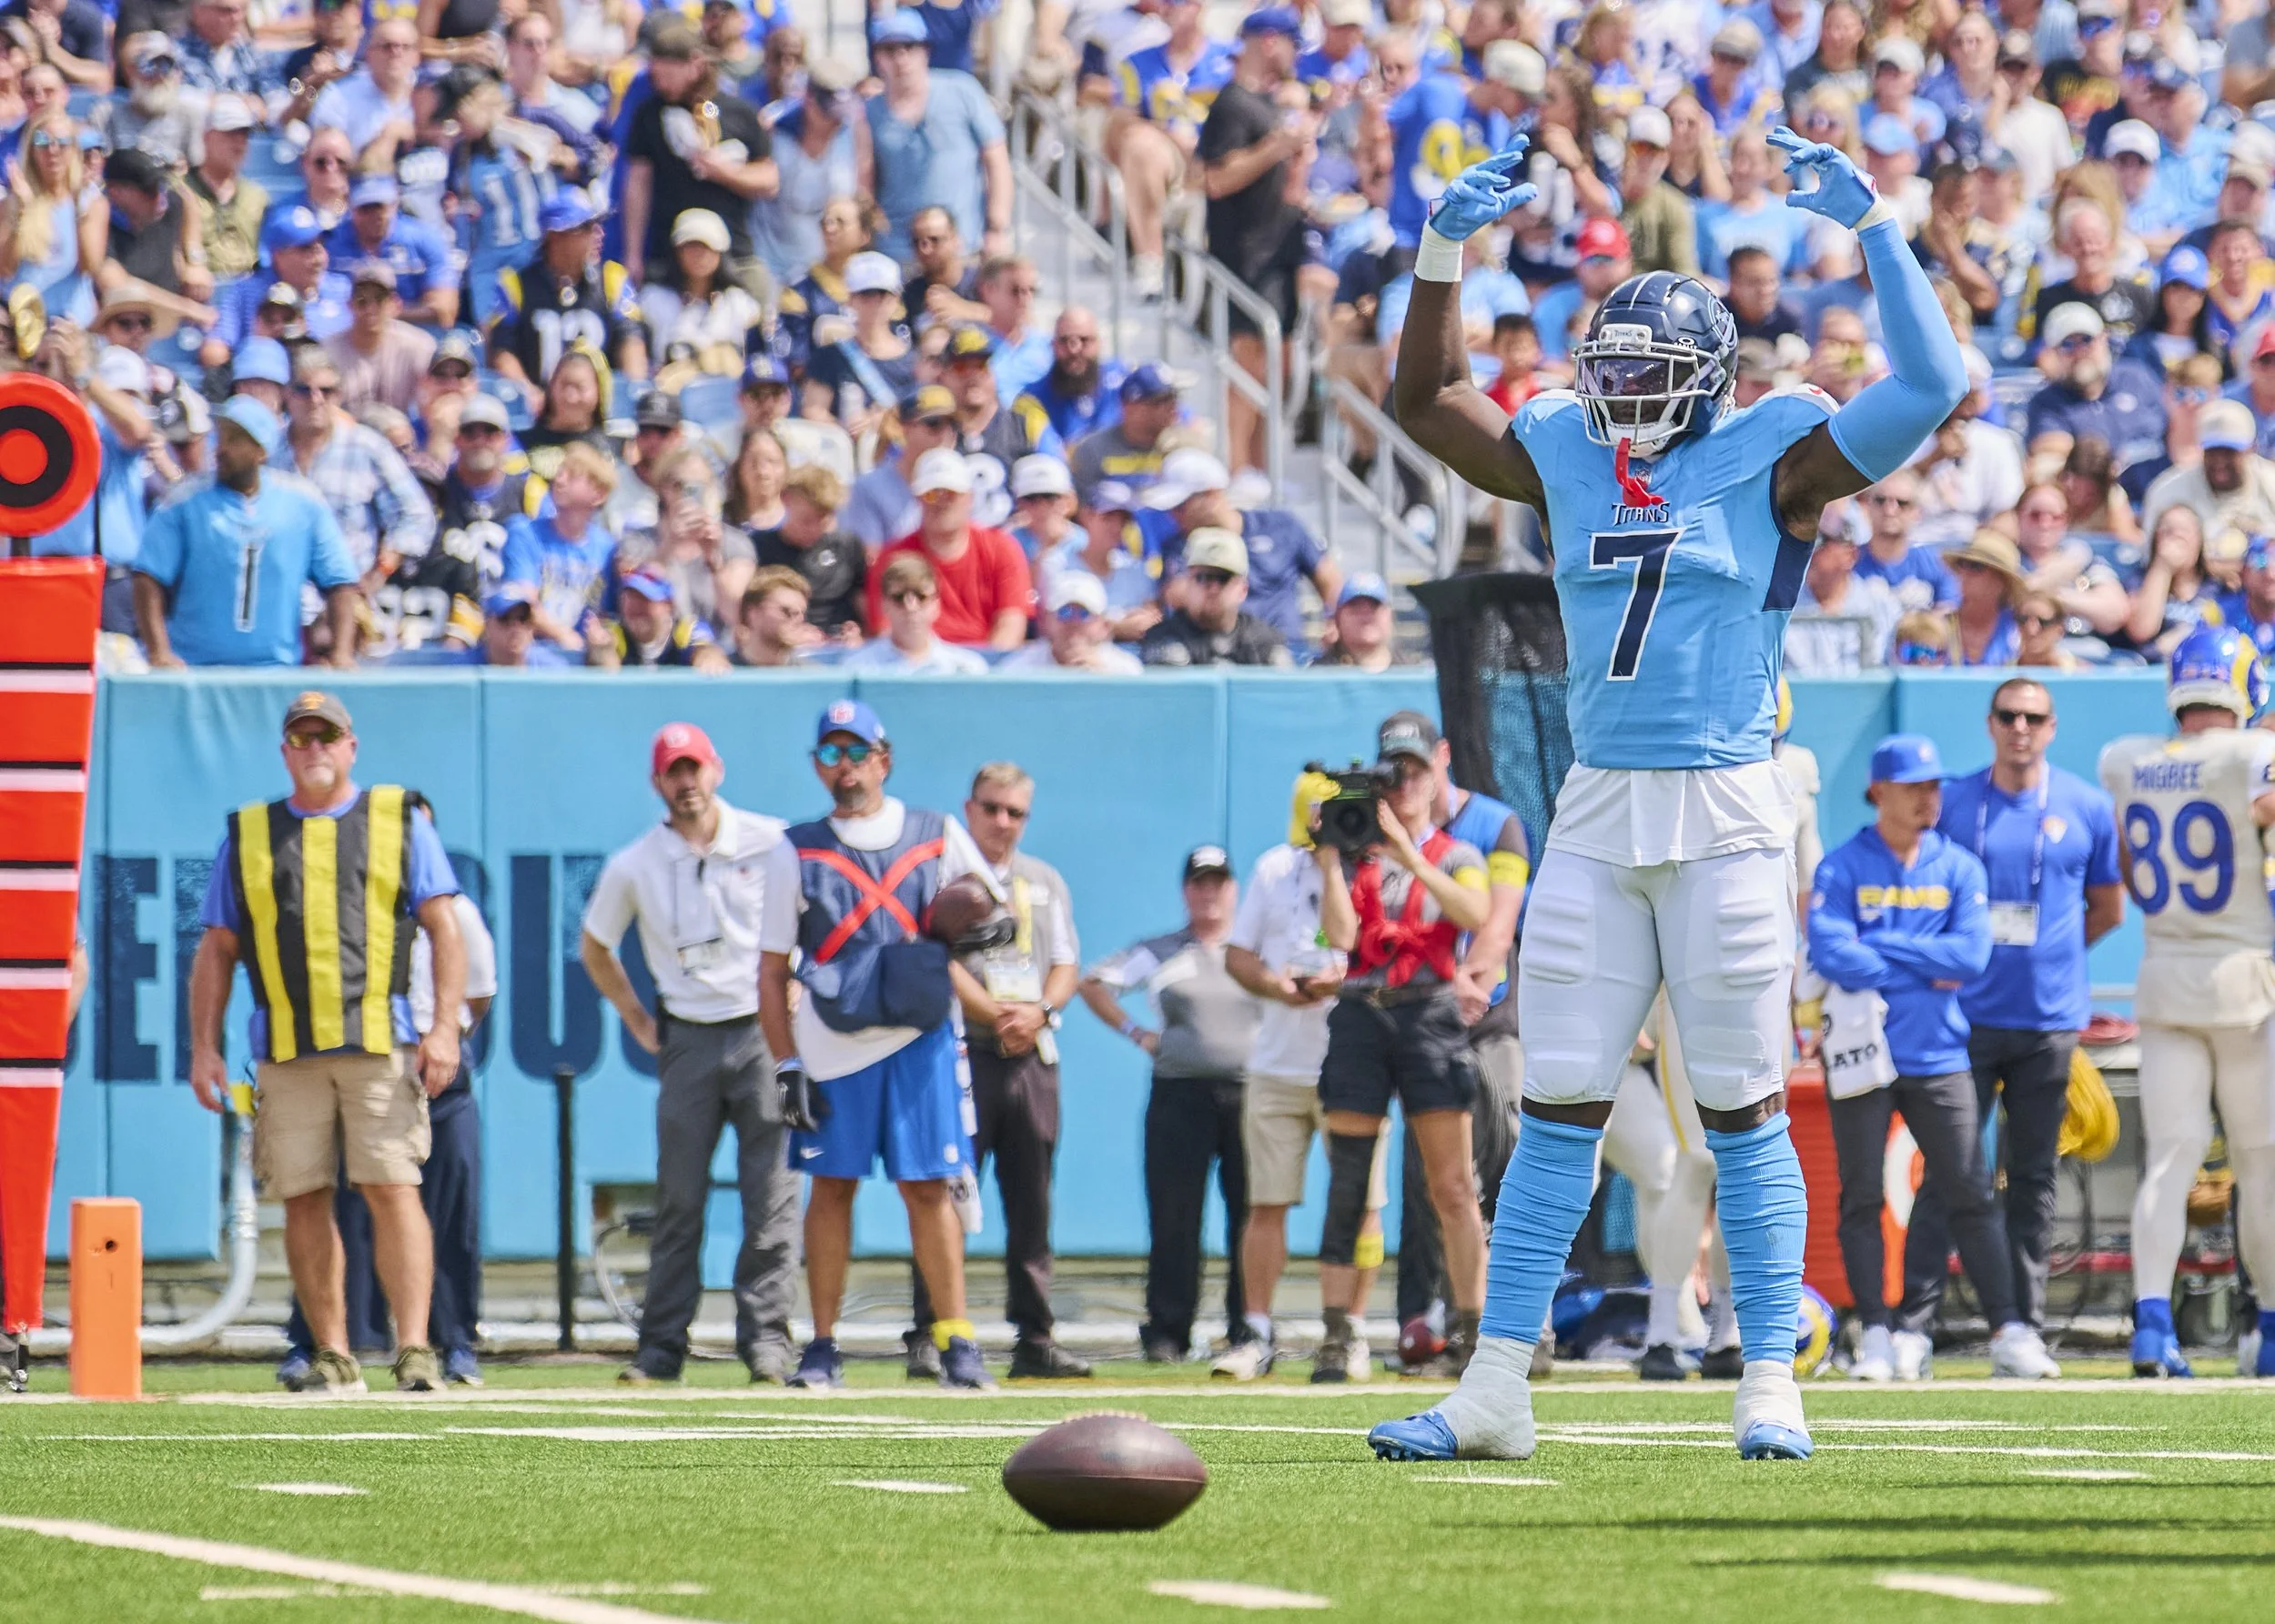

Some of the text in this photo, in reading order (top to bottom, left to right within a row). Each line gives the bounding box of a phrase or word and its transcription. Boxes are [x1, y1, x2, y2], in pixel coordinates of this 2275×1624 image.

[1612, 502, 1670, 527] TITANS
[234, 541, 263, 632] 1
[1590, 528, 1686, 681] 7
[2126, 801, 2234, 916] 89
[1832, 1043, 1878, 1068] ATO
